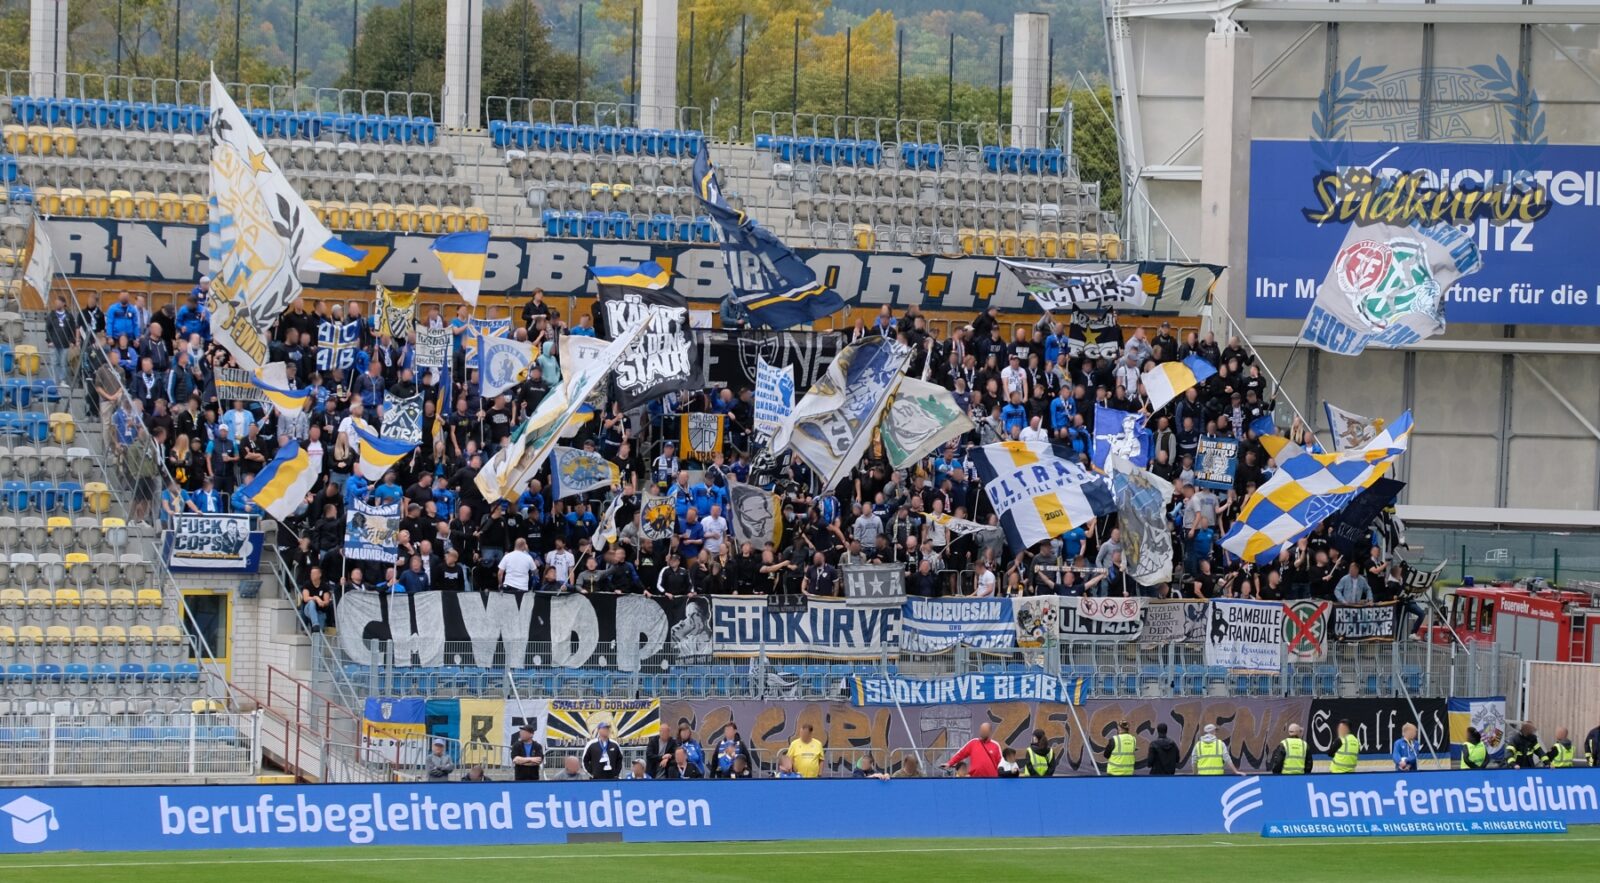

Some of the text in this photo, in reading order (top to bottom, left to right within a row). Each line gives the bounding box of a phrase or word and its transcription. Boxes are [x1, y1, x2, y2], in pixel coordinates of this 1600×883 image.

[1256, 278, 1287, 299] Ihr
[1509, 279, 1544, 304] für
[1551, 283, 1588, 306] die
[988, 460, 1087, 506] ULTRA
[1043, 509, 1065, 521] 2001
[176, 518, 223, 535] FUCK
[174, 534, 223, 551] COPS
[912, 600, 1002, 622] UNBEUGSAM
[1500, 597, 1530, 614] Feuerwehr
[1149, 612, 1174, 621] SPIEL
[1229, 606, 1281, 626] BAMBULE
[1335, 607, 1394, 623] REFUGEES
[714, 605, 900, 647] SÜDKURVE
[1149, 626, 1173, 635] DEIN
[1228, 624, 1281, 645] RANDALE
[1334, 622, 1393, 637] WELCOME
[863, 672, 1072, 703] SÜDKURVE BLEIBT
[552, 700, 601, 710] SAALFELD
[1306, 776, 1600, 818] hsm-fernstudium
[159, 789, 712, 844] berufsbegleitend studieren
[1283, 823, 1370, 834] RINGBERG HOTEL
[1382, 822, 1469, 833] RINGBERG HOTEL
[1483, 820, 1567, 831] RINGBERG HOTEL
